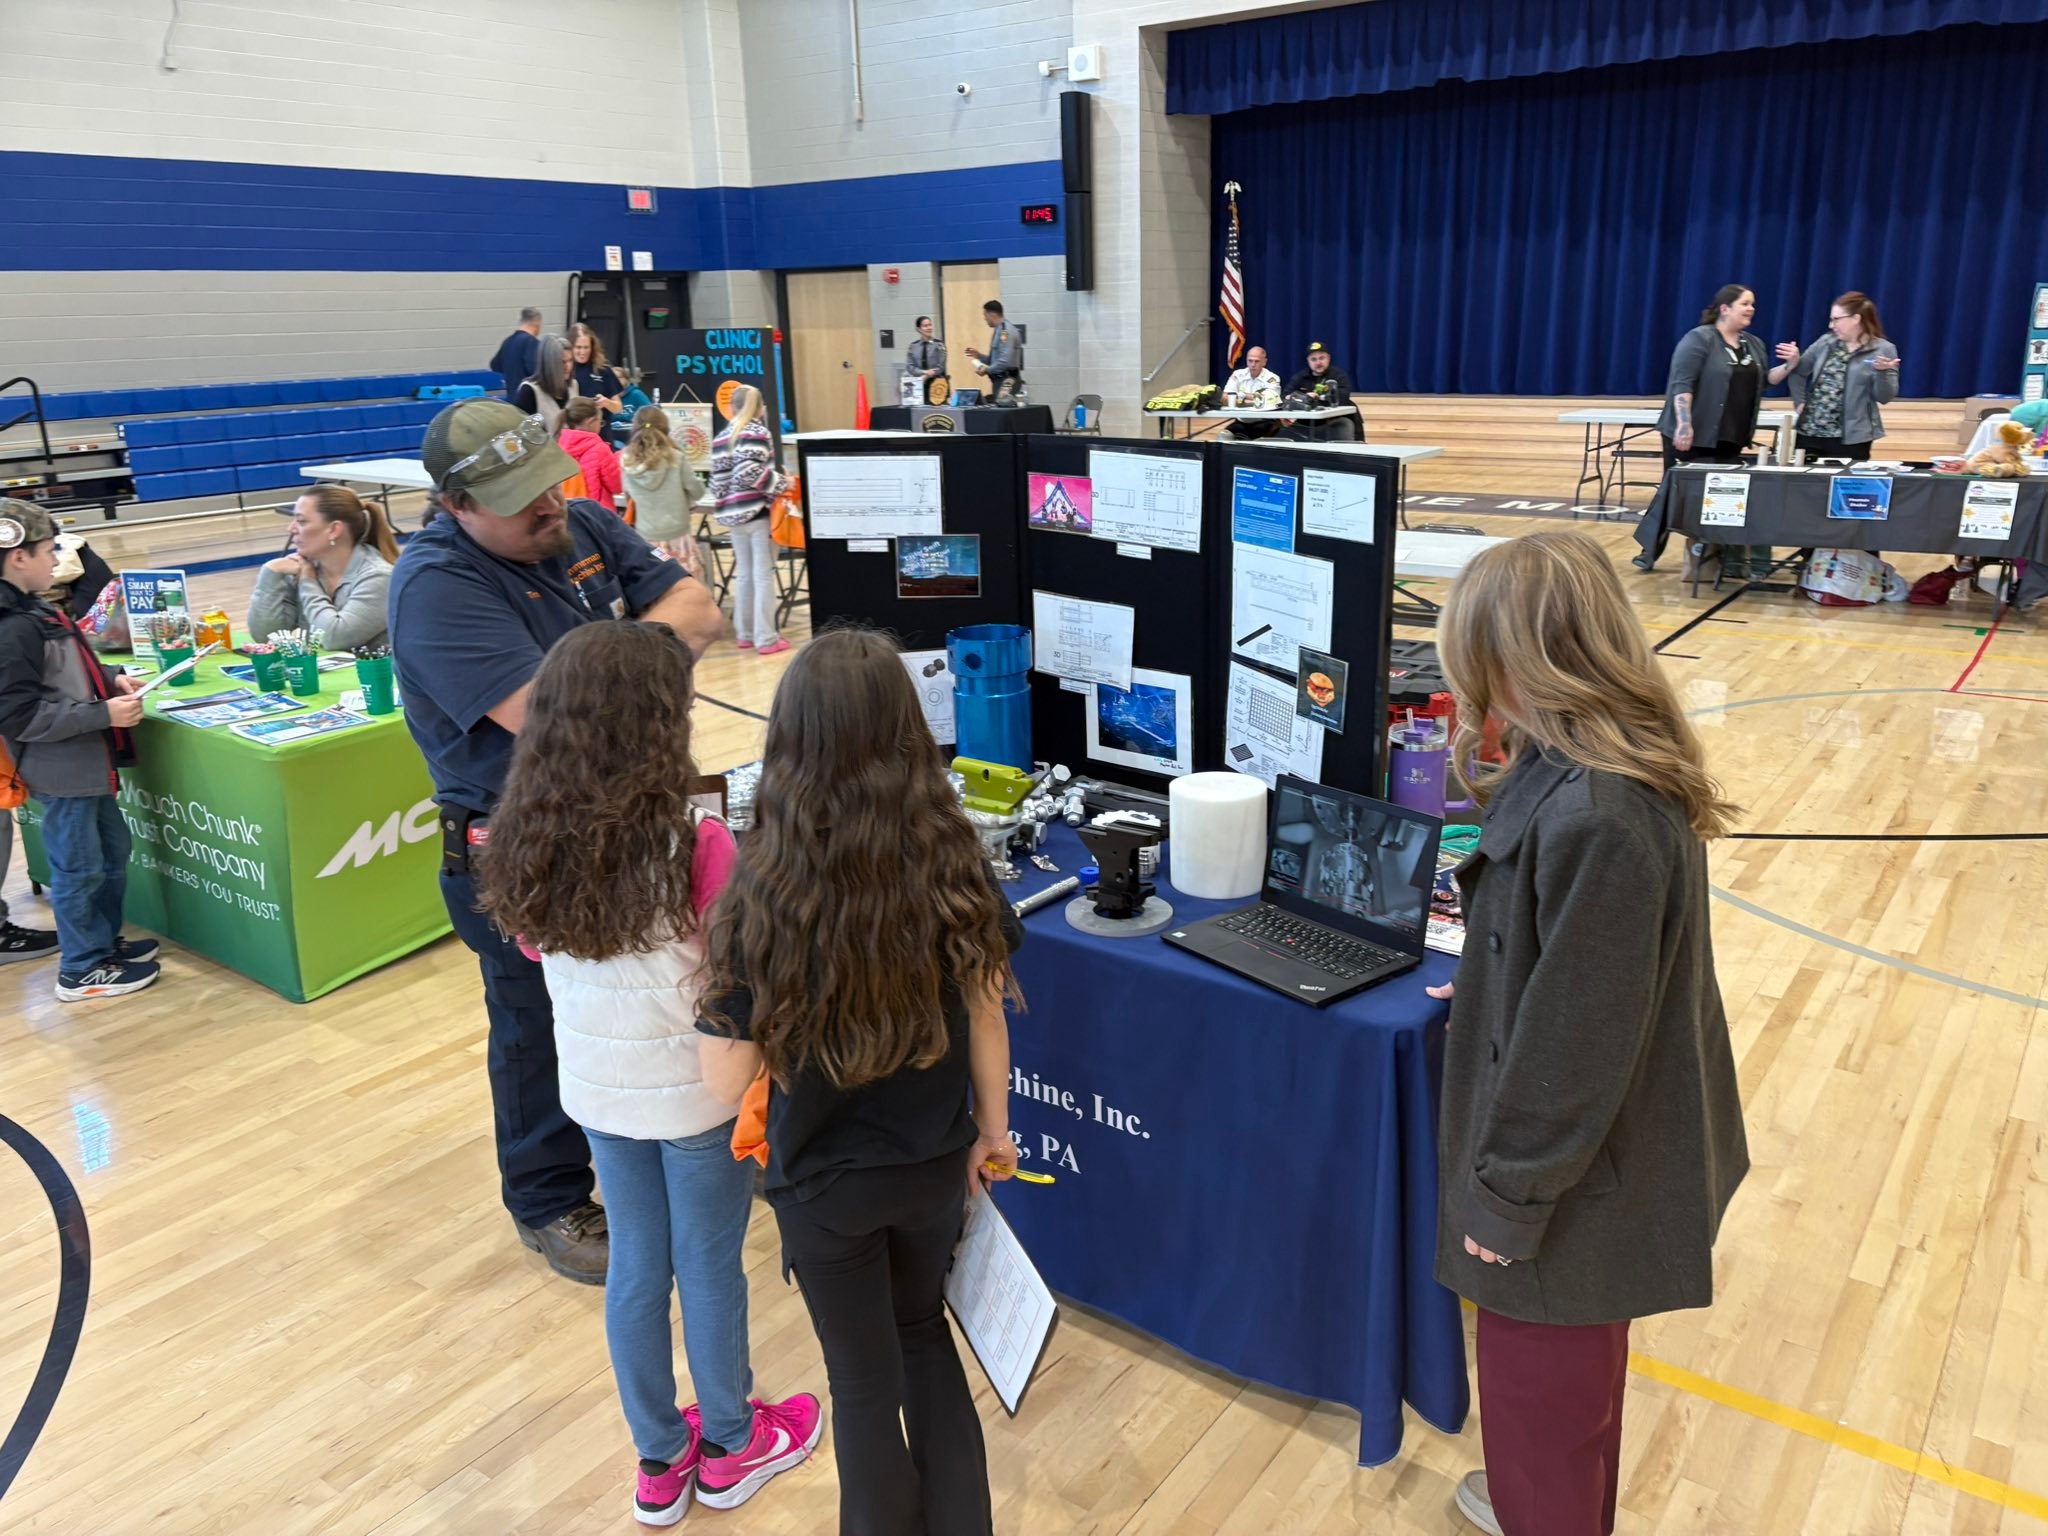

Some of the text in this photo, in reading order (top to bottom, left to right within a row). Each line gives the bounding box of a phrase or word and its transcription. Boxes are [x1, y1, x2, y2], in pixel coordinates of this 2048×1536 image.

[127, 581, 154, 590] SMART
[130, 596, 154, 610] PAY
[119, 775, 188, 824] Mauch
[118, 806, 266, 891] Trust Company
[140, 853, 201, 890] BANKERS
[201, 877, 233, 904] YOU
[1092, 1093, 1152, 1140] Inc.
[1039, 1132, 1083, 1175] PA
